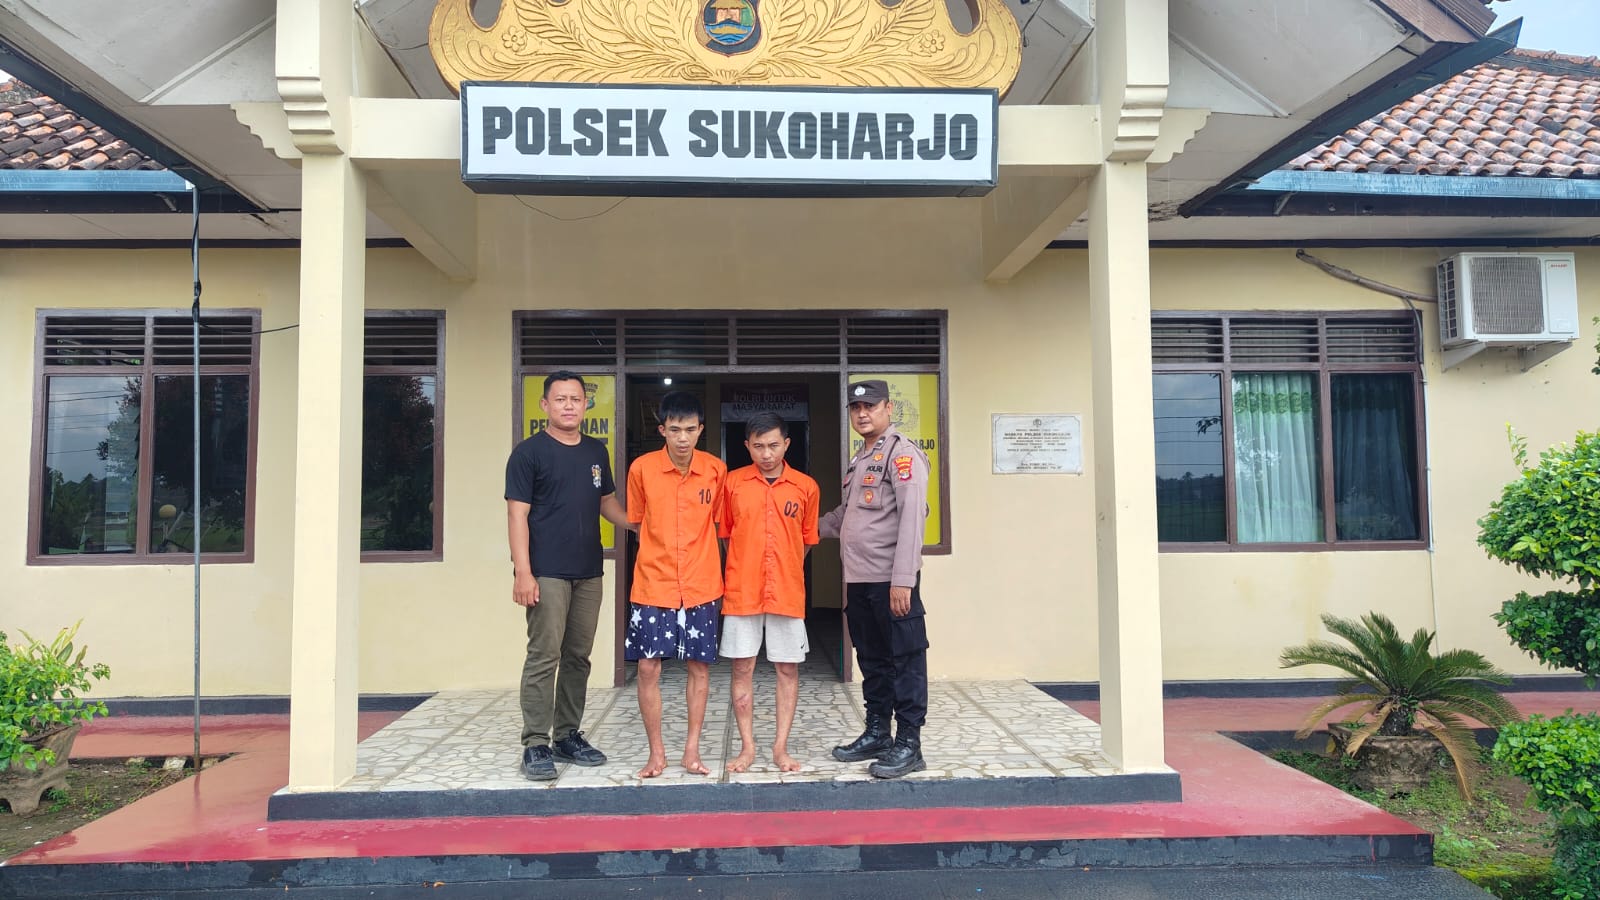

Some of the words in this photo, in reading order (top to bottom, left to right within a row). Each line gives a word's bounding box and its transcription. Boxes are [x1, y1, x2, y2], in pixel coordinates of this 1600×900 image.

[482, 106, 669, 157] POLSEK
[688, 109, 978, 161] SUKOHARJO
[699, 488, 711, 504] 10
[784, 501, 799, 518] 02
